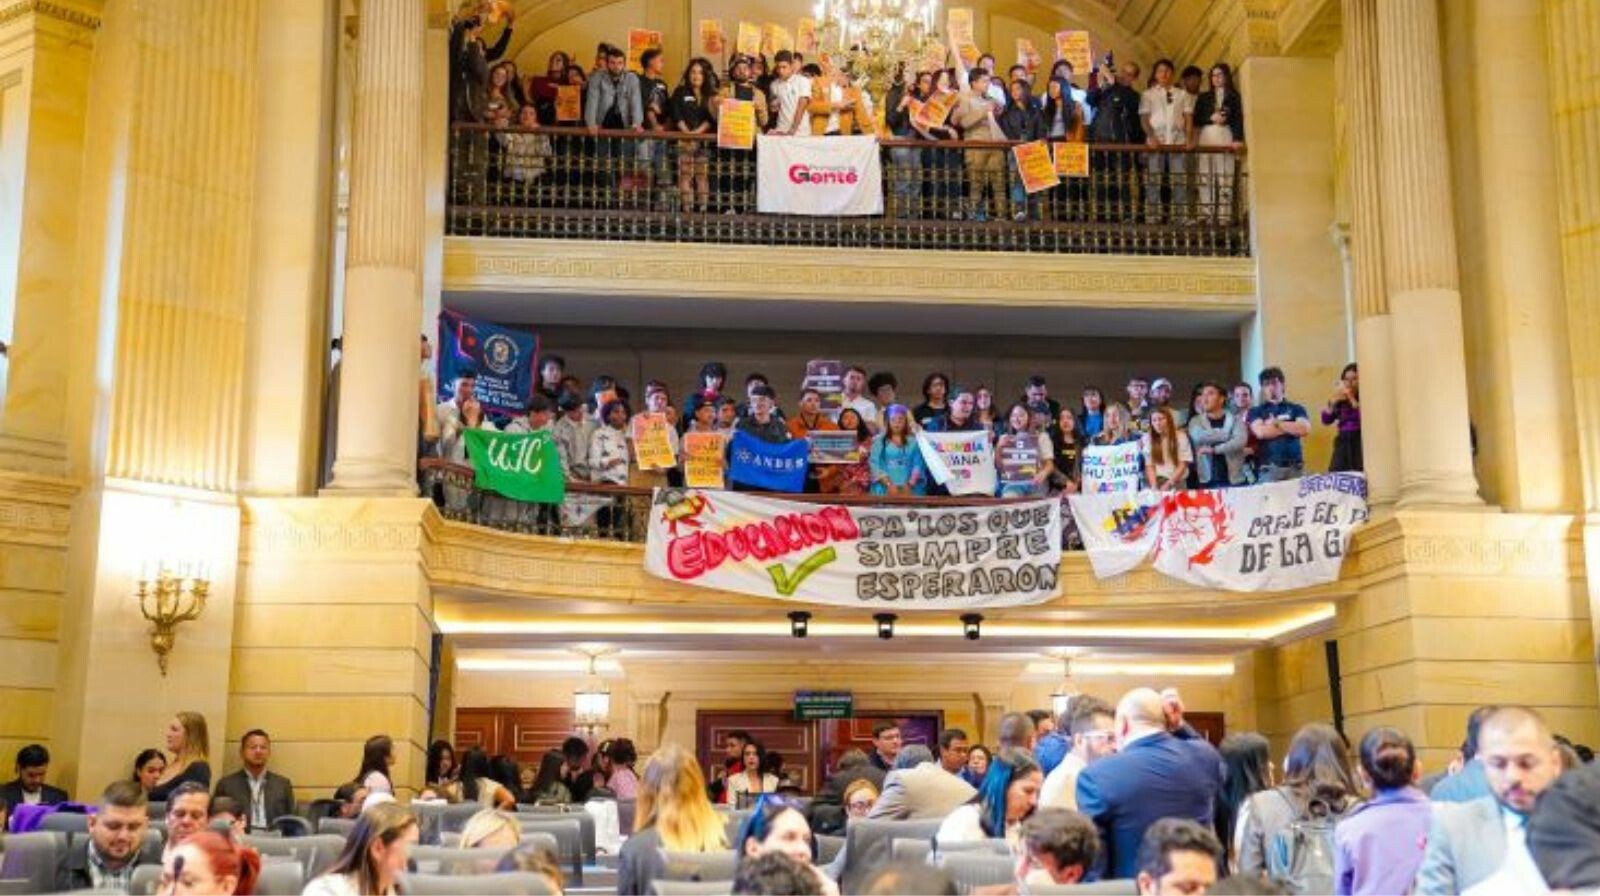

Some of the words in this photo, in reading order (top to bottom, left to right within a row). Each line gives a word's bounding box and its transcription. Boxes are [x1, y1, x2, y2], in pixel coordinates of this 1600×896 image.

[753, 455, 804, 469] ANDES
[988, 504, 1051, 533] QUE
[1312, 502, 1338, 525] EL
[668, 506, 858, 579] EDUCACION
[856, 528, 1050, 568] SIEMPRE
[1280, 533, 1314, 567] LA
[1323, 529, 1343, 558] G
[857, 563, 1060, 600] ESPERARON
